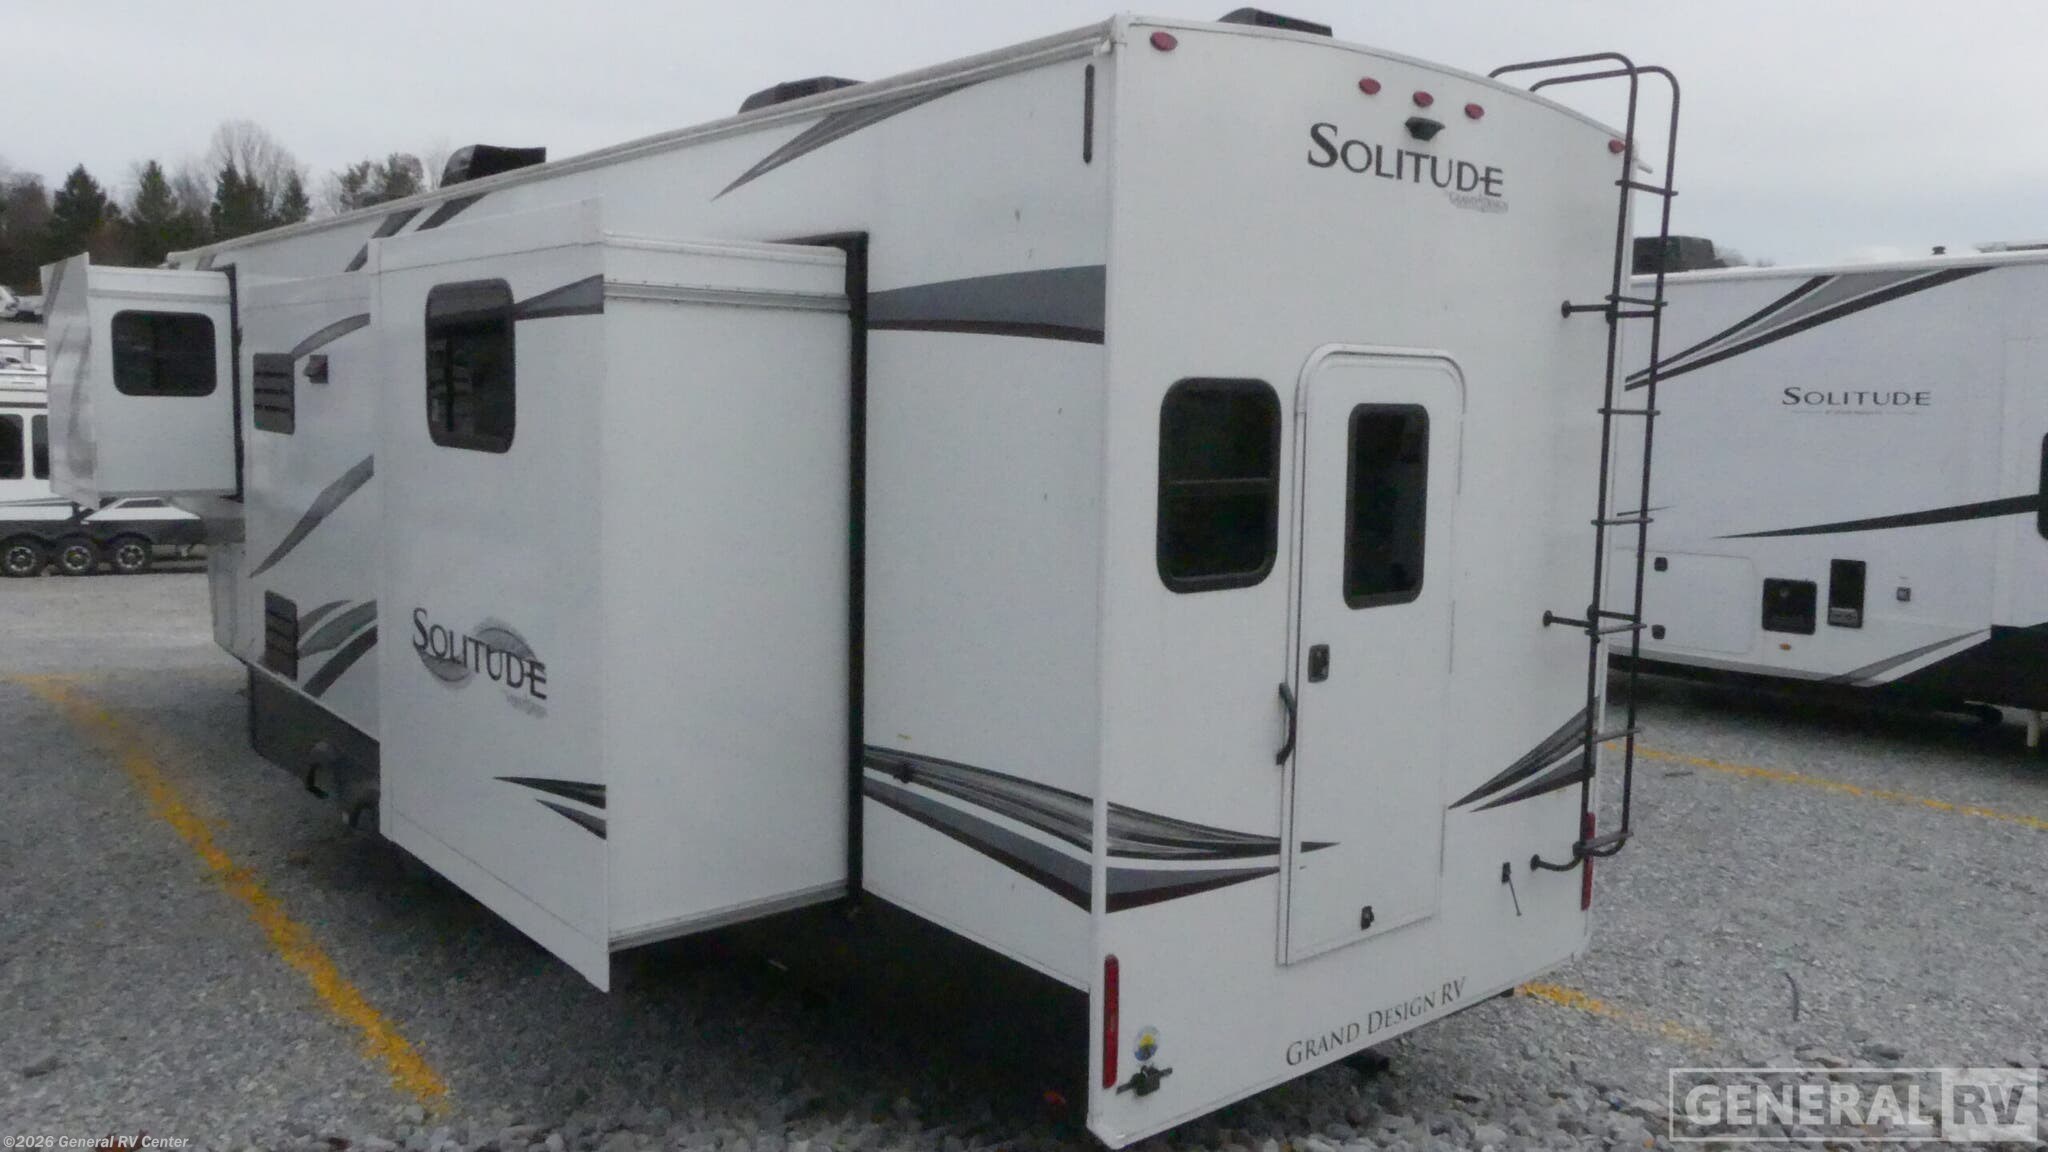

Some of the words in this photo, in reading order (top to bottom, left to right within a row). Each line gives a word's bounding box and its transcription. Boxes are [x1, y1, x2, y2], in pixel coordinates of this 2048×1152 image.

[1308, 122, 1504, 198] SOLITUDE
[1782, 386, 1932, 406] SOLITUDE
[412, 607, 547, 700] SOLITUDE
[1286, 1022, 1361, 1066] GRAND
[1367, 991, 1436, 1035] DESIGN
[1441, 976, 1466, 1005] RV
